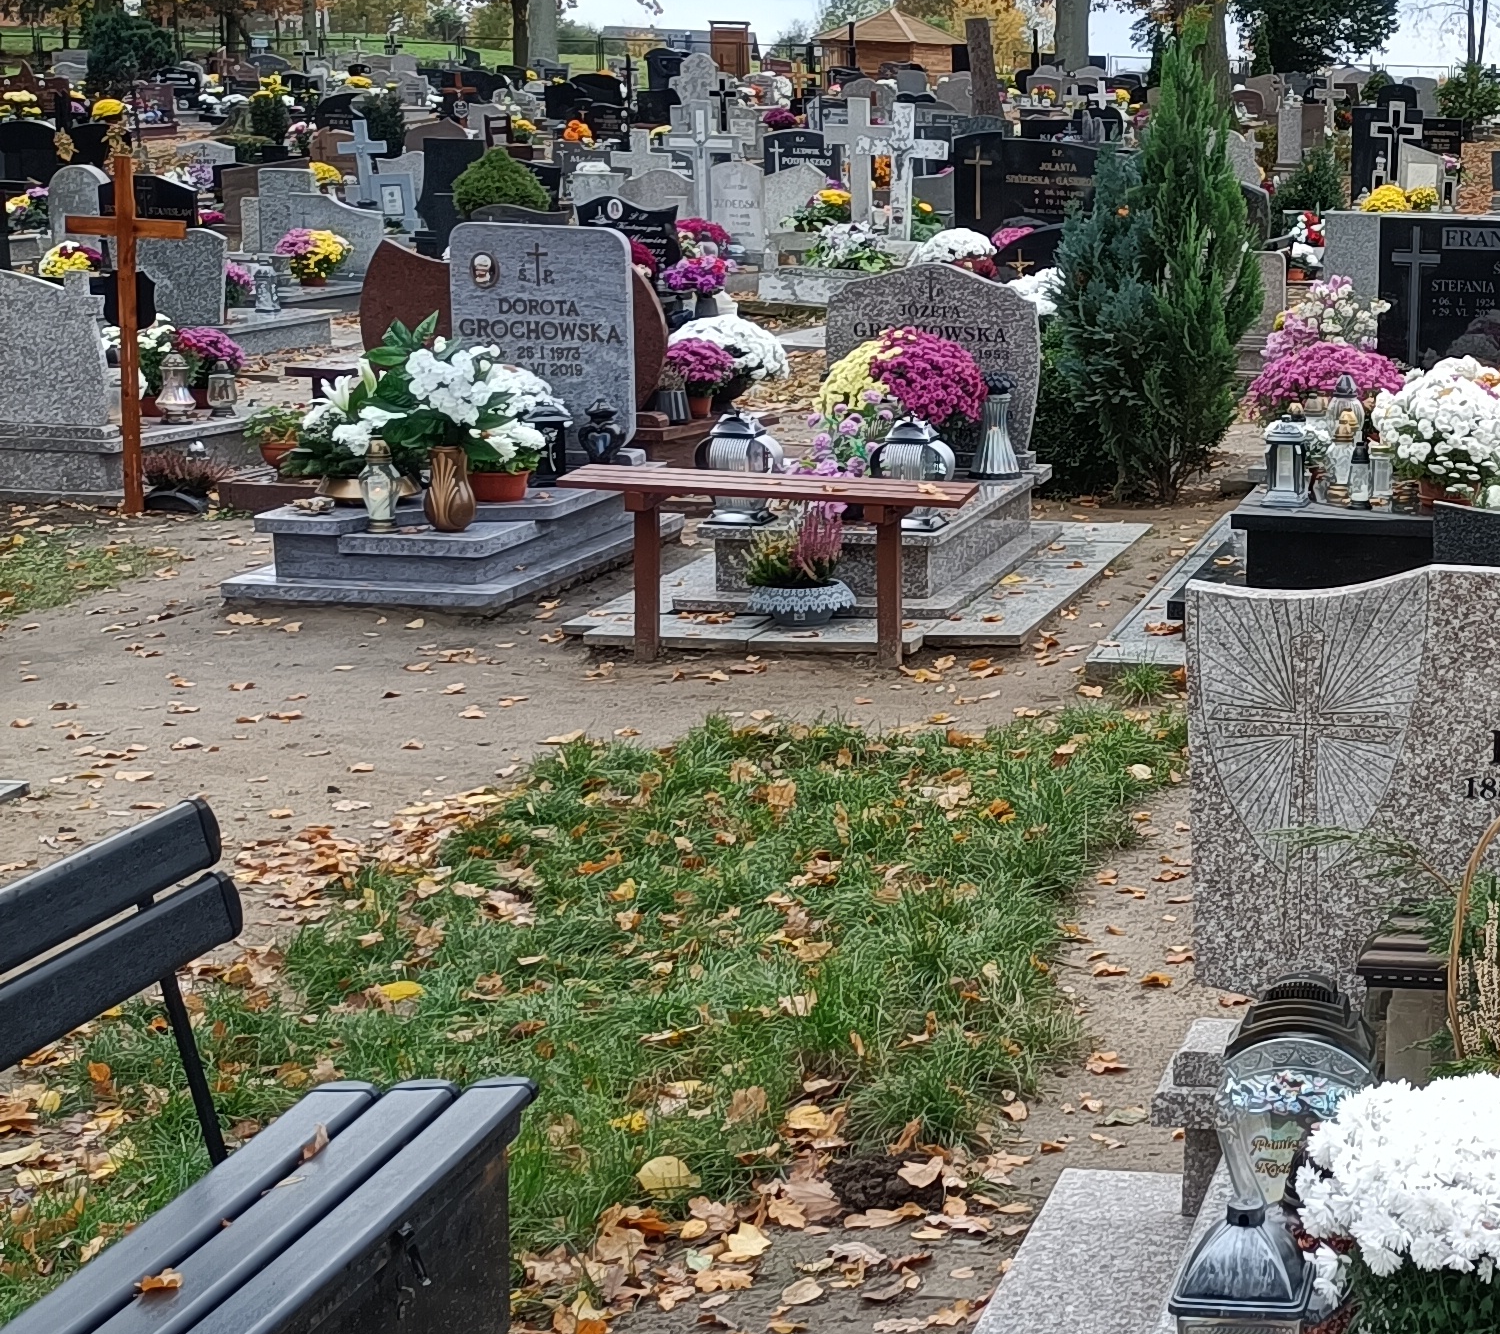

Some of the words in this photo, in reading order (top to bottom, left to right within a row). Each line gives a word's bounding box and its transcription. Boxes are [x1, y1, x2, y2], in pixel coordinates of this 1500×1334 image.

[1431, 279, 1495, 294] STEFANIA
[498, 297, 581, 317] DOROTA
[899, 301, 961, 318] JÓZEFA
[458, 318, 623, 345] GROCHOWSKA
[549, 362, 583, 377] 2019
